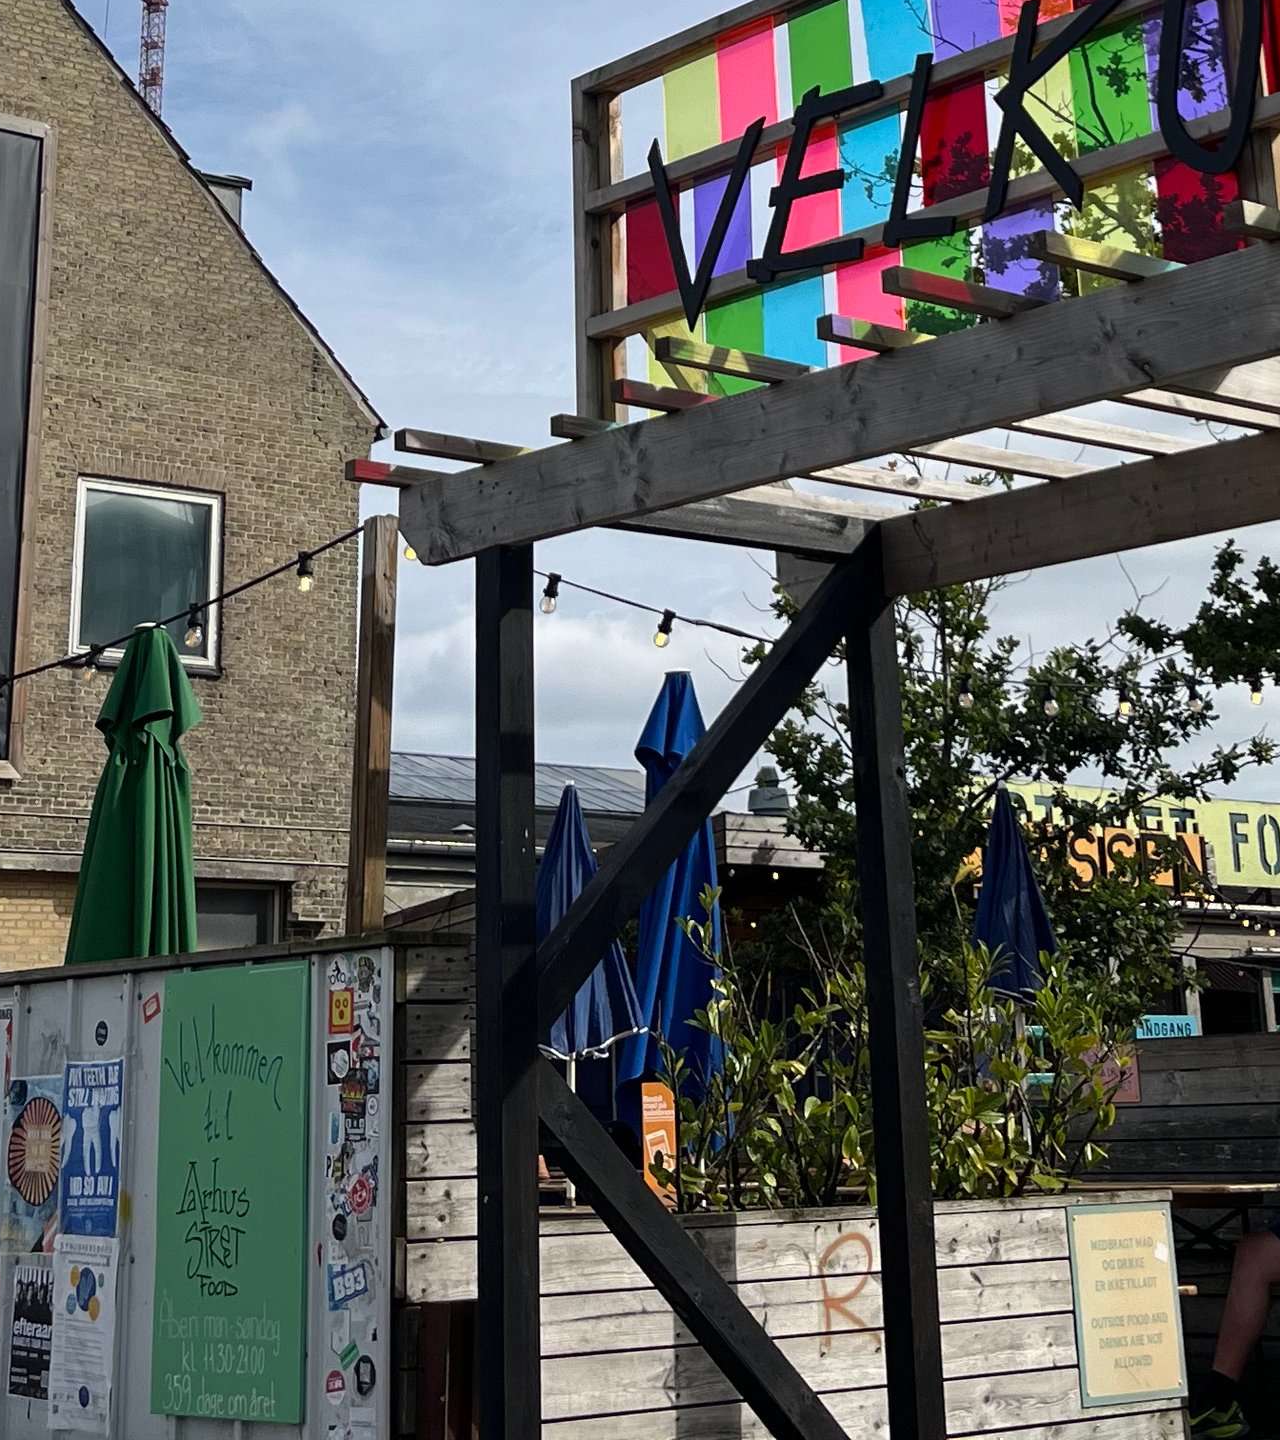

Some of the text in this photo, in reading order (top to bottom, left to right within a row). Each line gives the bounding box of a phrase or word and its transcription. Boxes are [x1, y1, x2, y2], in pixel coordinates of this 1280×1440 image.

[204, 1089, 234, 1143] til
[175, 1157, 250, 1225] Aarhus
[1135, 1236, 1154, 1250] MAD
[1102, 1257, 1146, 1271] OG DRIKKE
[333, 1267, 366, 1302] B93
[1095, 1279, 1107, 1292] ER
[1108, 1278, 1125, 1291] IKKE
[1091, 1312, 1169, 1330] OUTSIDE FOOD AND
[1099, 1332, 1164, 1350] DRINKS ARE NOT
[1114, 1354, 1154, 1369] ALLOWED
[162, 1373, 276, 1418] 359 dage om året
